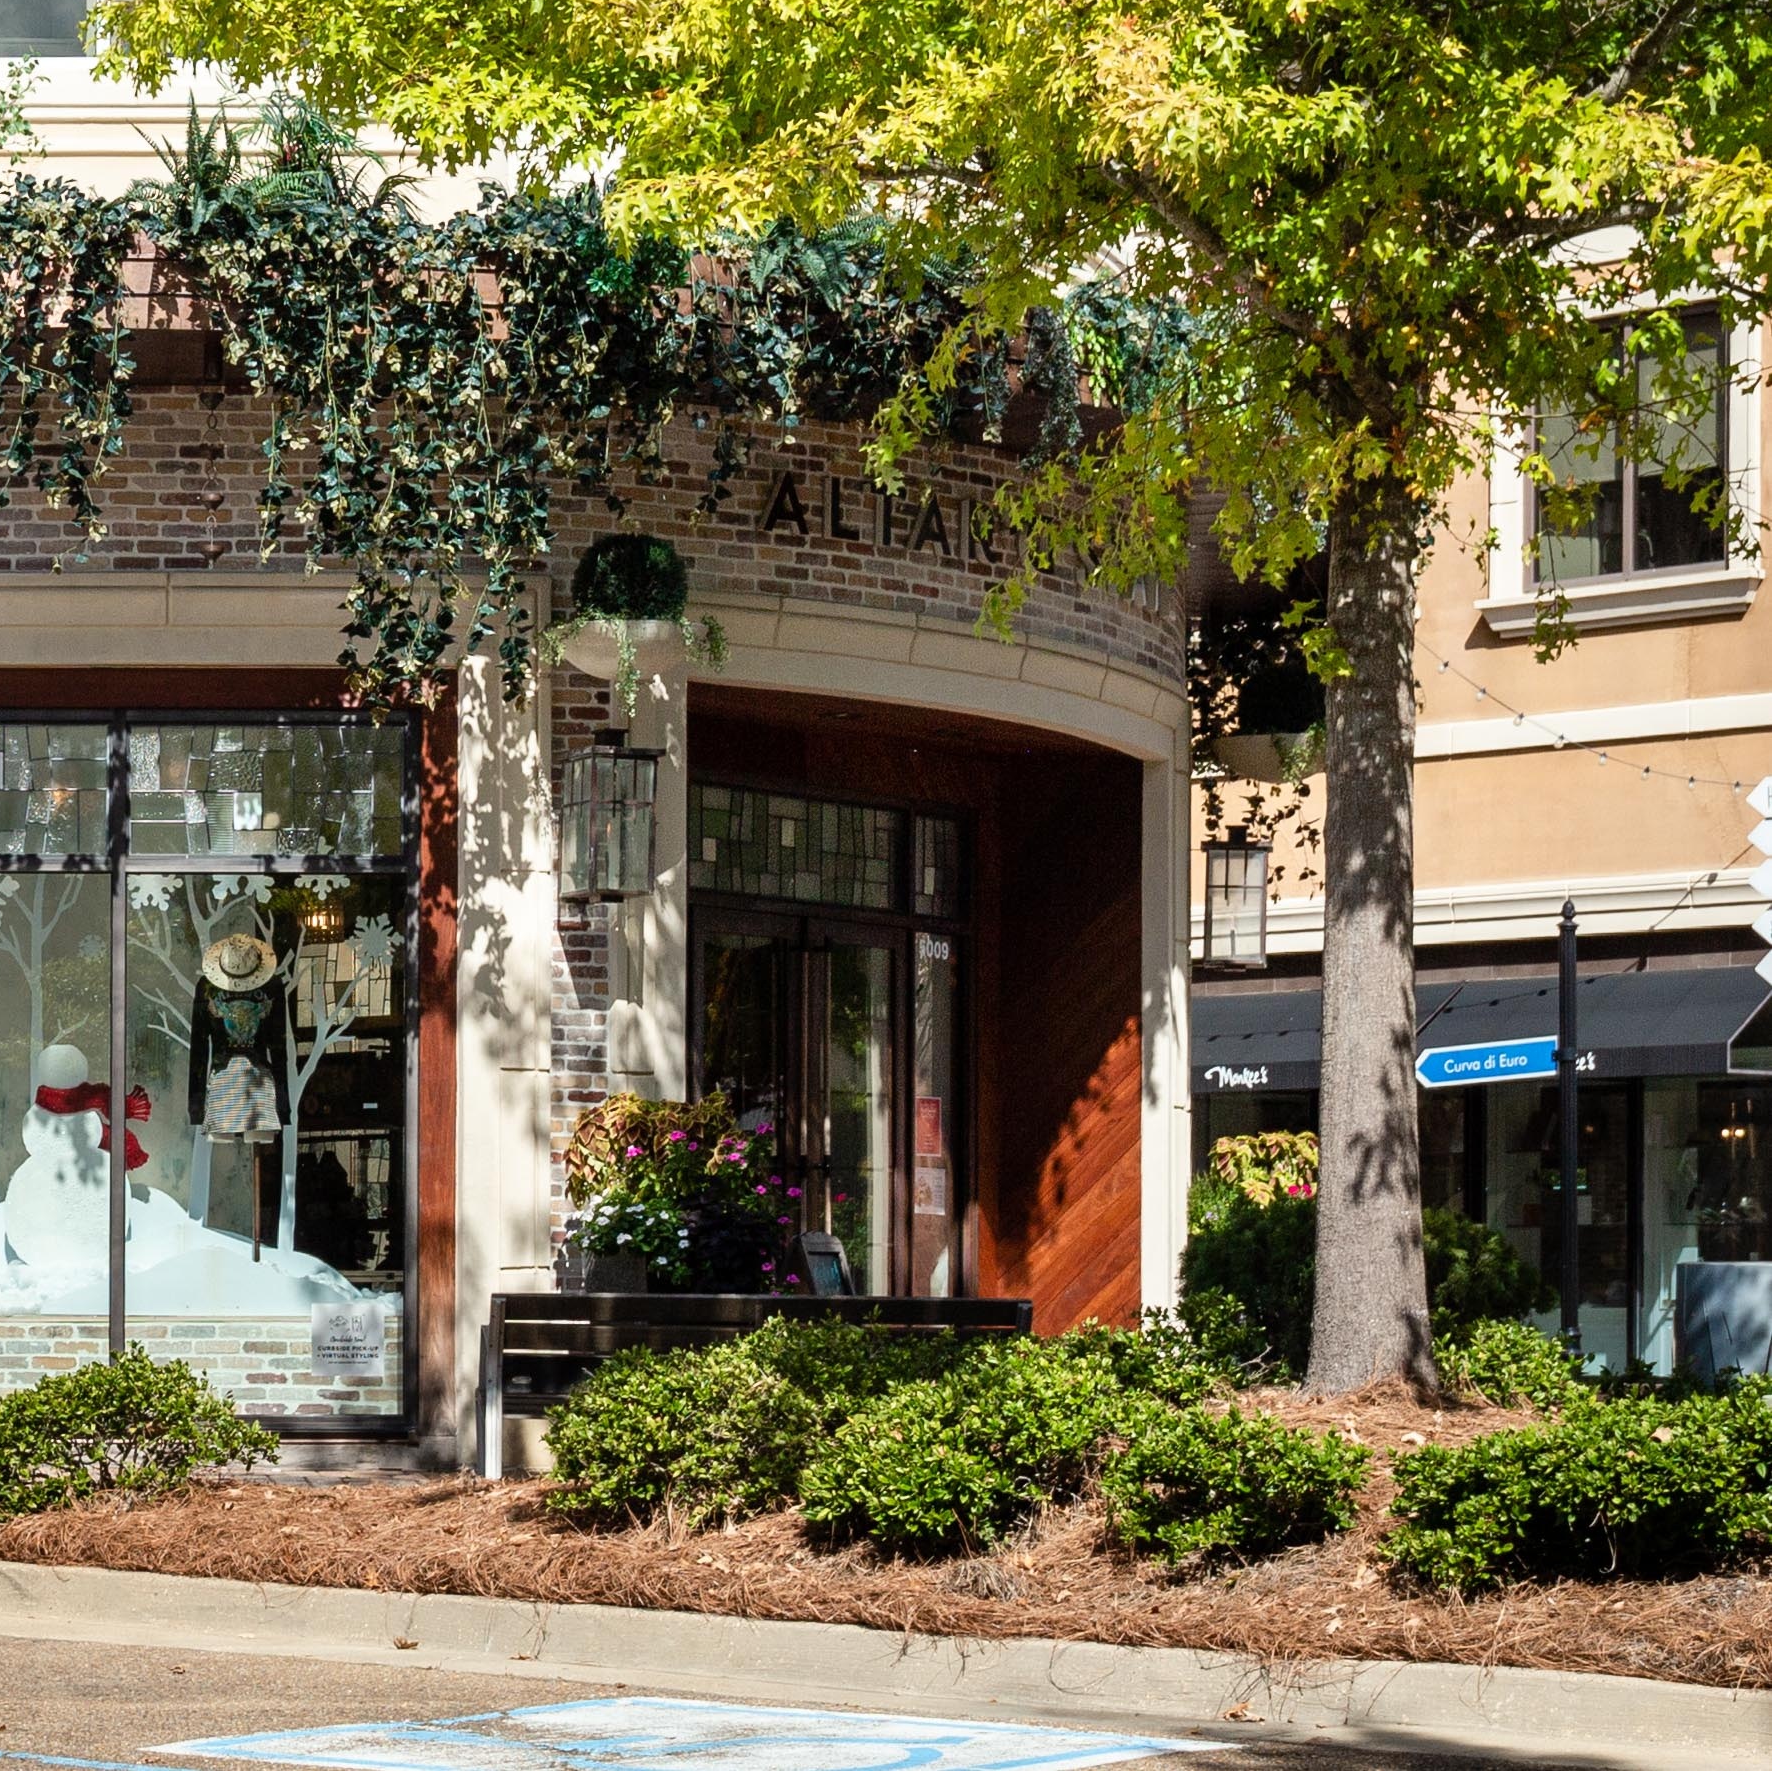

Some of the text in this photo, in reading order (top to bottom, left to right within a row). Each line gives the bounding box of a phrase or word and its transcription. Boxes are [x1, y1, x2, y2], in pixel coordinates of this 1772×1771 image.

[1443, 1053, 1528, 1074] Curva di Euro
[1203, 1065, 1269, 1089] Monkee's
